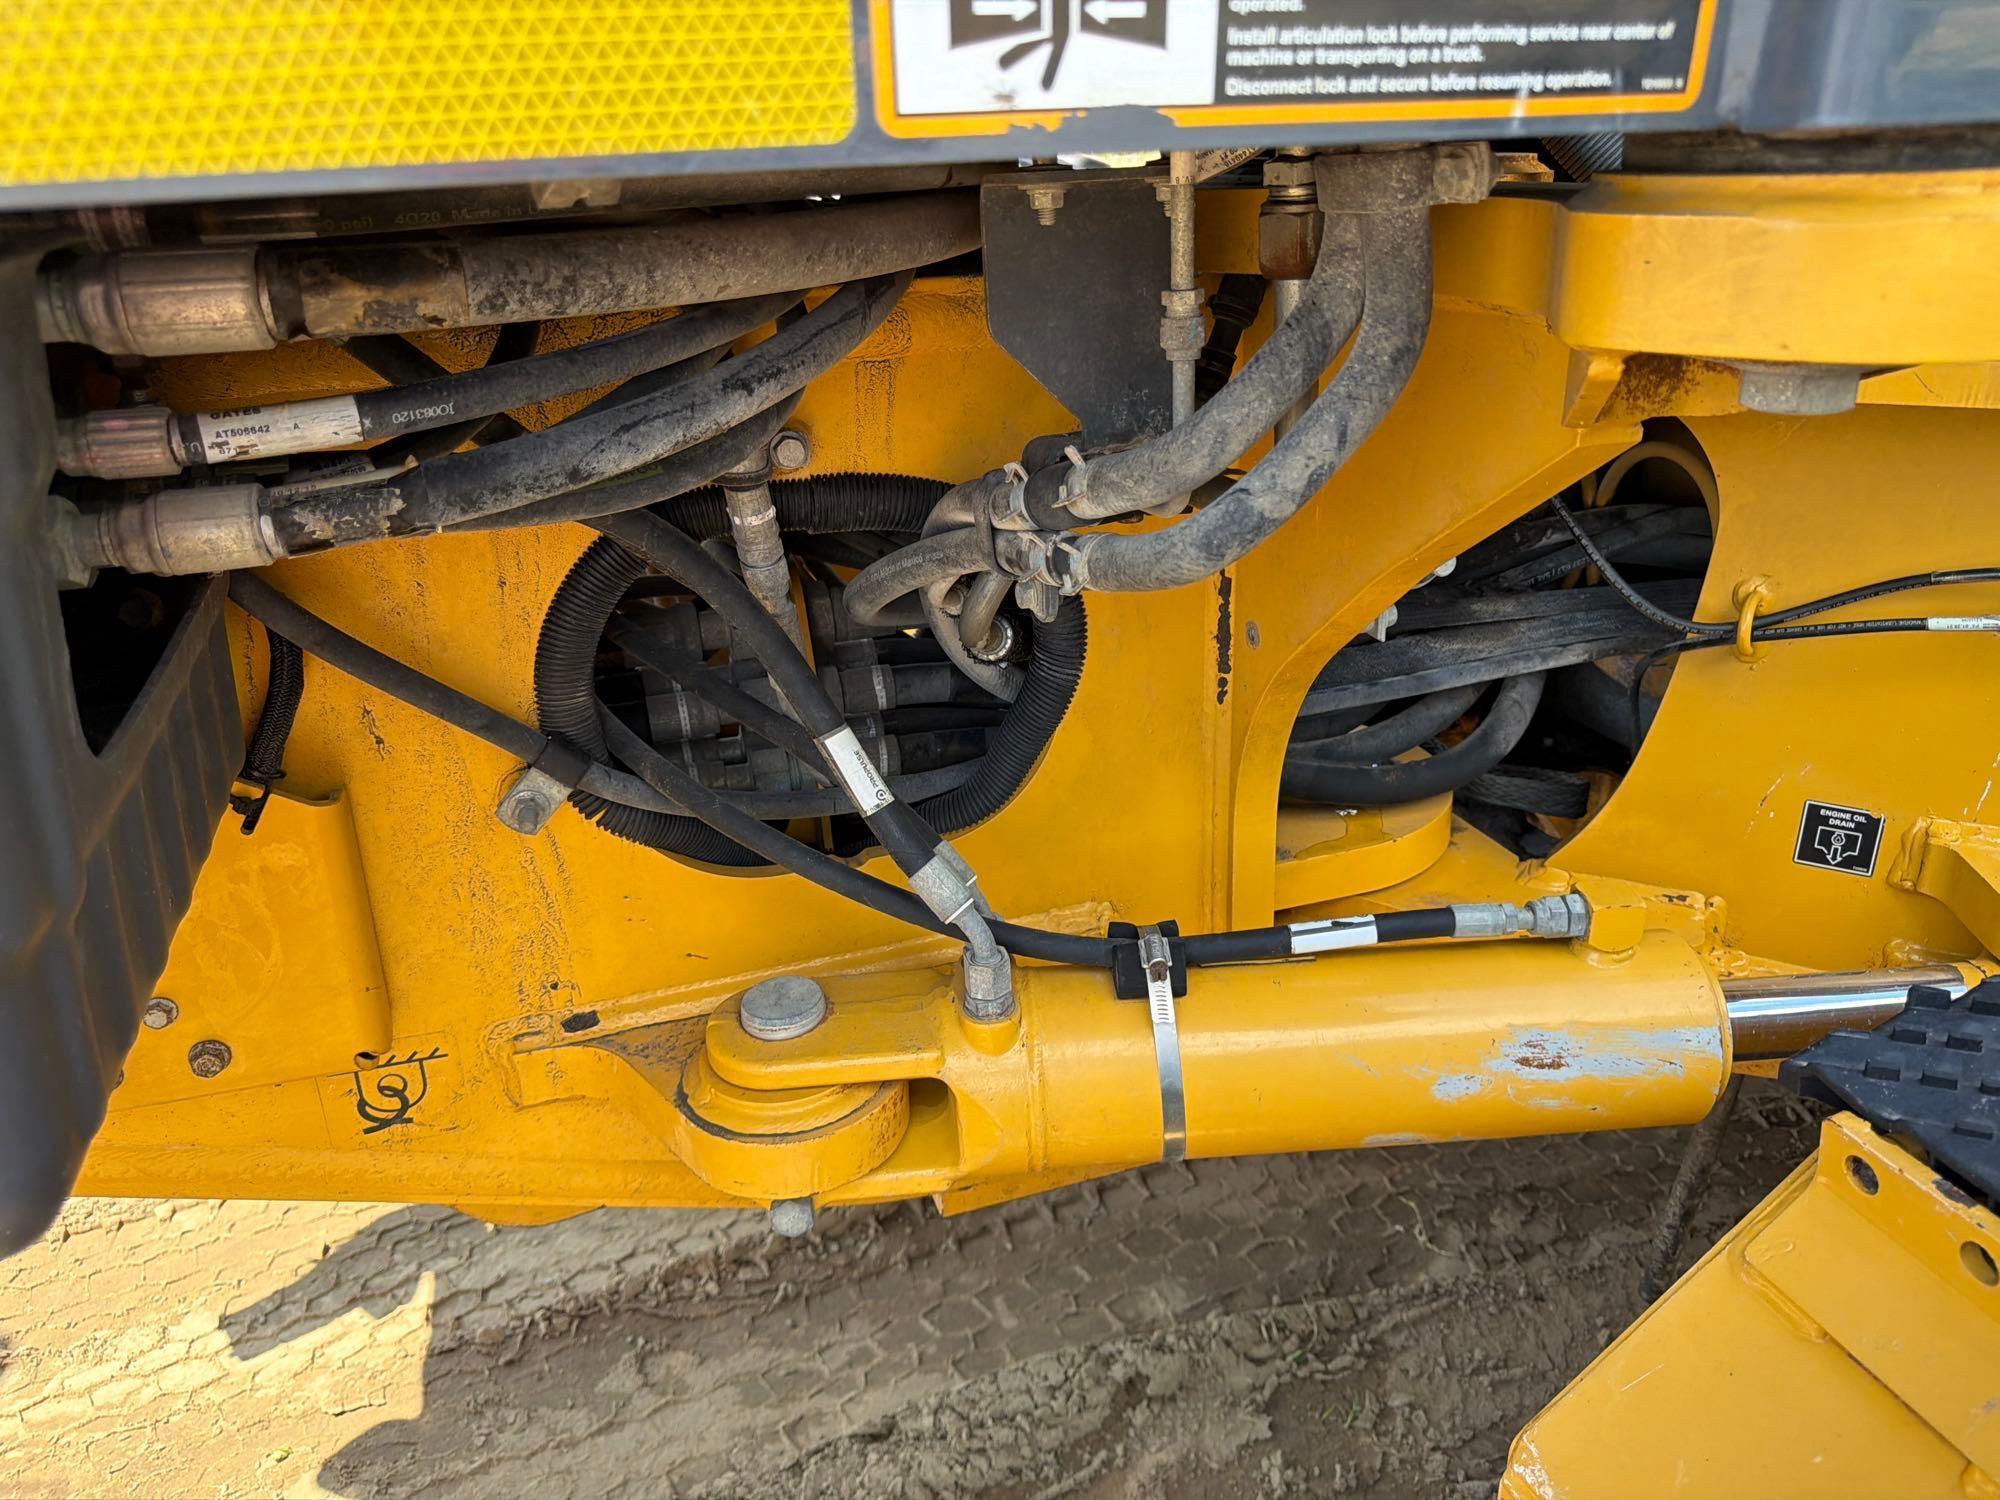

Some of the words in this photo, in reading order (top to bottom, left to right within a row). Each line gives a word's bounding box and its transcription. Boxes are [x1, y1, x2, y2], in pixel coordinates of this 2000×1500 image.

[1227, 24, 1277, 45] Install
[1279, 24, 1364, 45] articulation
[1366, 24, 1398, 43] lock
[1400, 21, 1448, 43] before
[1449, 20, 1528, 46] performing
[1656, 19, 1676, 40] of
[1226, 46, 1294, 66] machine
[1295, 50, 1313, 66] or
[1315, 46, 1407, 68] transporting
[1408, 49, 1428, 64] on
[1429, 49, 1441, 63] a
[1442, 44, 1485, 64] truck.
[1224, 76, 1312, 96] Disconnect
[1314, 74, 1346, 94] lock
[1349, 73, 1379, 93] and
[1379, 76, 1429, 93] secure
[1431, 71, 1477, 92] before
[1478, 71, 1545, 93] resuming
[1820, 808, 1852, 821] ENGINE
[1853, 814, 1867, 823] OIL
[1829, 818, 1855, 828] DRAIN
